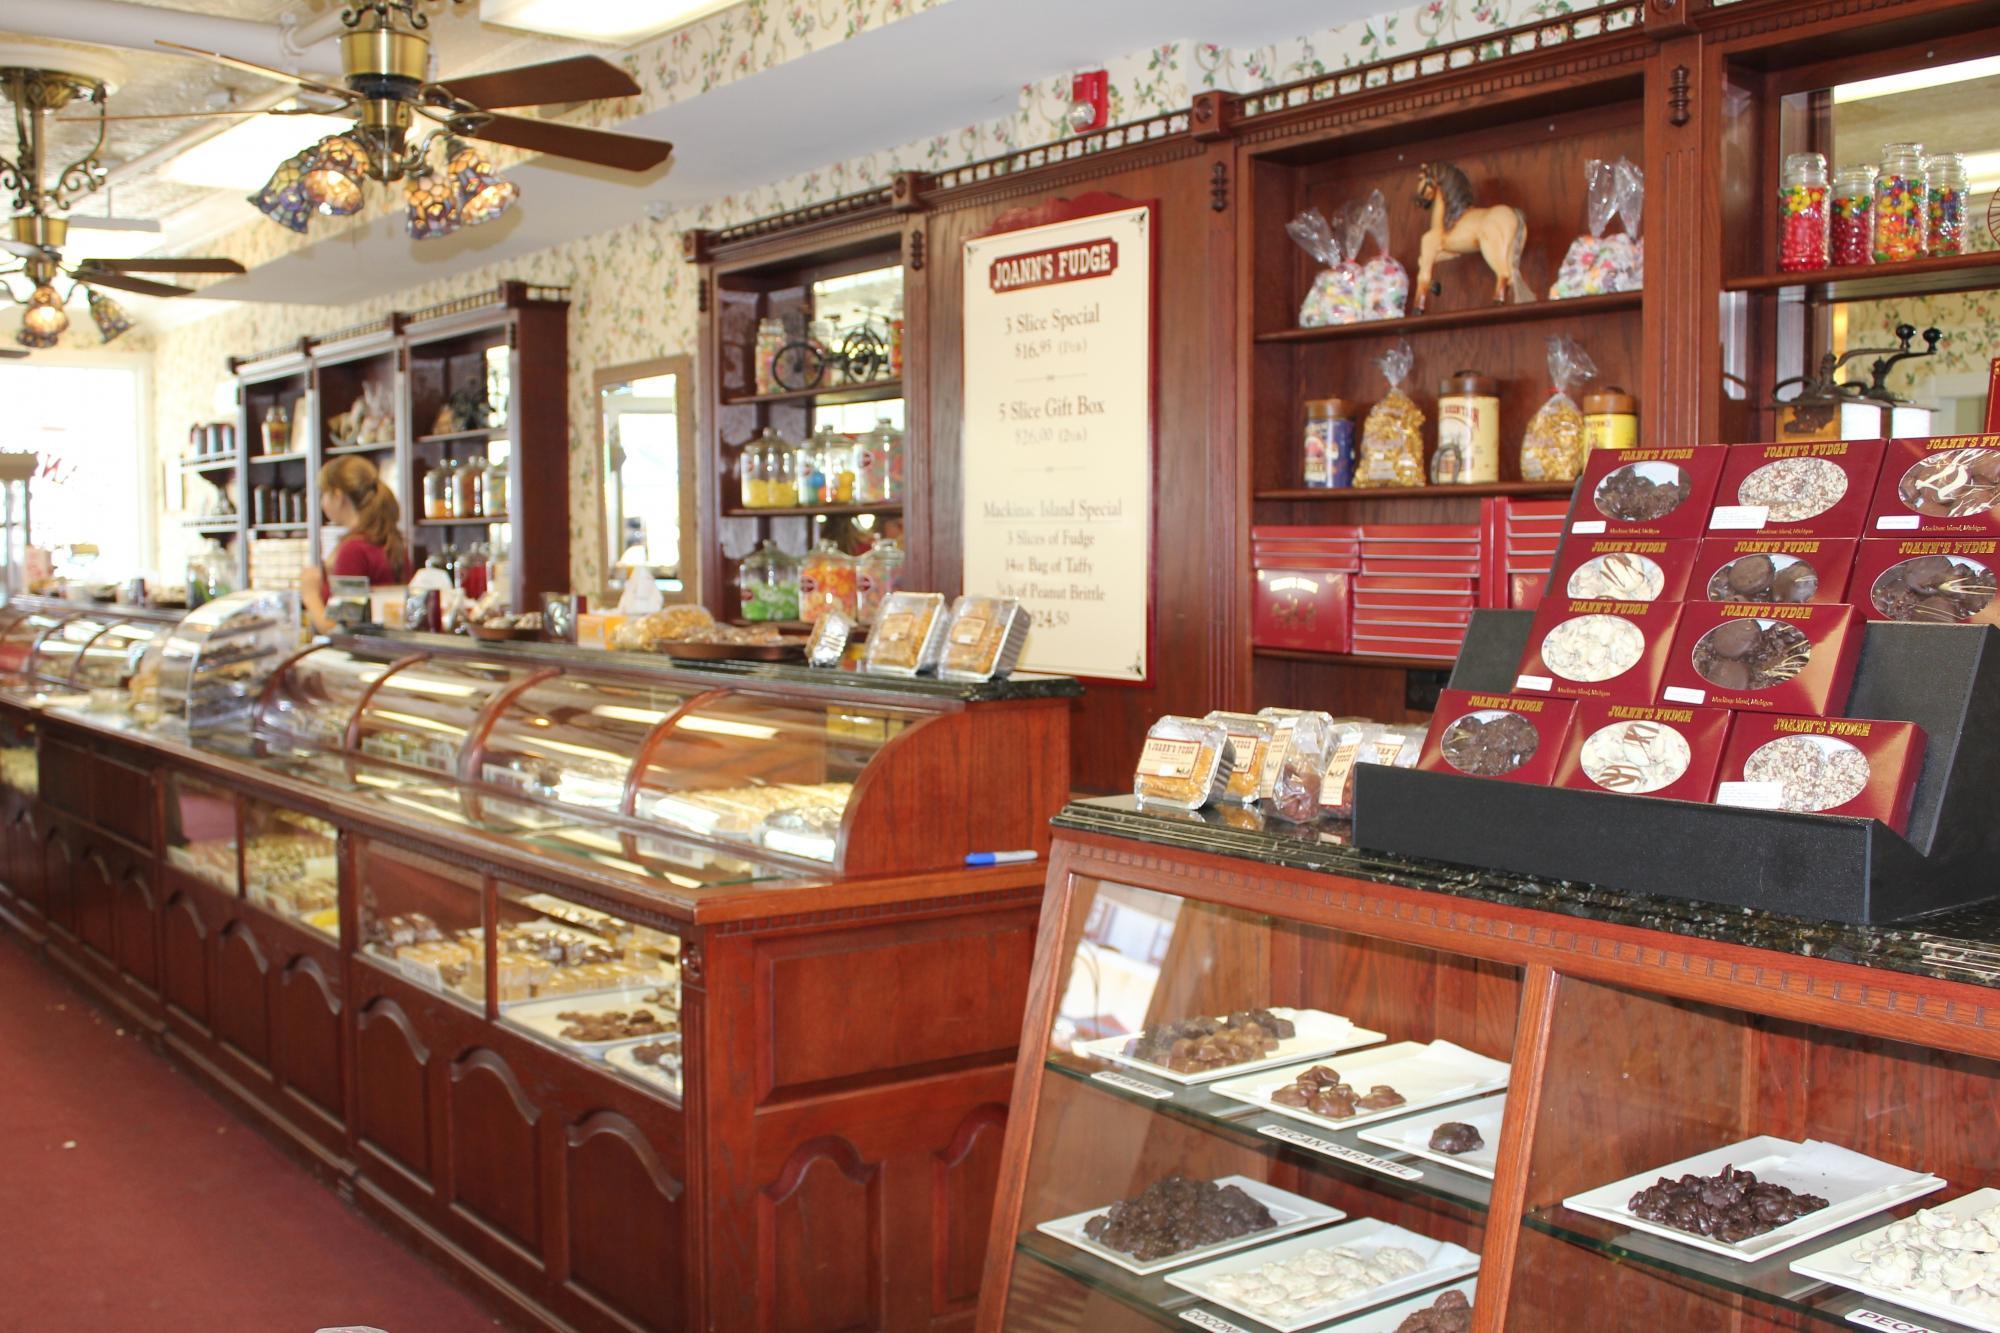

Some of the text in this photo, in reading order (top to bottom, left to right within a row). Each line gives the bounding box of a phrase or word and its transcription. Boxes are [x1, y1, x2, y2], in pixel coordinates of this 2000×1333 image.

[994, 243, 1111, 289] JOANN'S FUDGE
[1005, 303, 1100, 336] 3 Slice Special
[999, 395, 1105, 421] 5 Slice Gift Box
[1763, 442, 1848, 458] JOANN'S FUDGE
[1926, 435, 2000, 449] JOANN'S FU
[1618, 448, 1694, 461] JOANN'S FUDGE
[1039, 499, 1074, 518] Island
[1079, 498, 1122, 521] Special
[1048, 530, 1059, 546] of
[1062, 529, 1095, 548] Fudge
[1592, 542, 1667, 553] JOANN'S FUDGE
[1734, 541, 1819, 553] JOANN'S FUDGE
[1899, 541, 1996, 554] JOANN'S FUDGE
[1028, 557, 1048, 575] Bag
[1051, 557, 1061, 572] of
[1066, 557, 1093, 575] Taffy
[1029, 582, 1066, 600] Peanut
[1069, 584, 1106, 601] Brittle
[1569, 601, 1649, 615] JOANN'S FUDGE
[1721, 605, 1813, 619] JOANN'S FUDGE
[1468, 695, 1544, 712] JOANN'S FUDGE
[1608, 705, 1694, 723] JOANN'S FUDGE
[1773, 718, 1872, 737] JOANN'S FUDGE
[1265, 1126, 1408, 1176] PECAN CARAMEL
